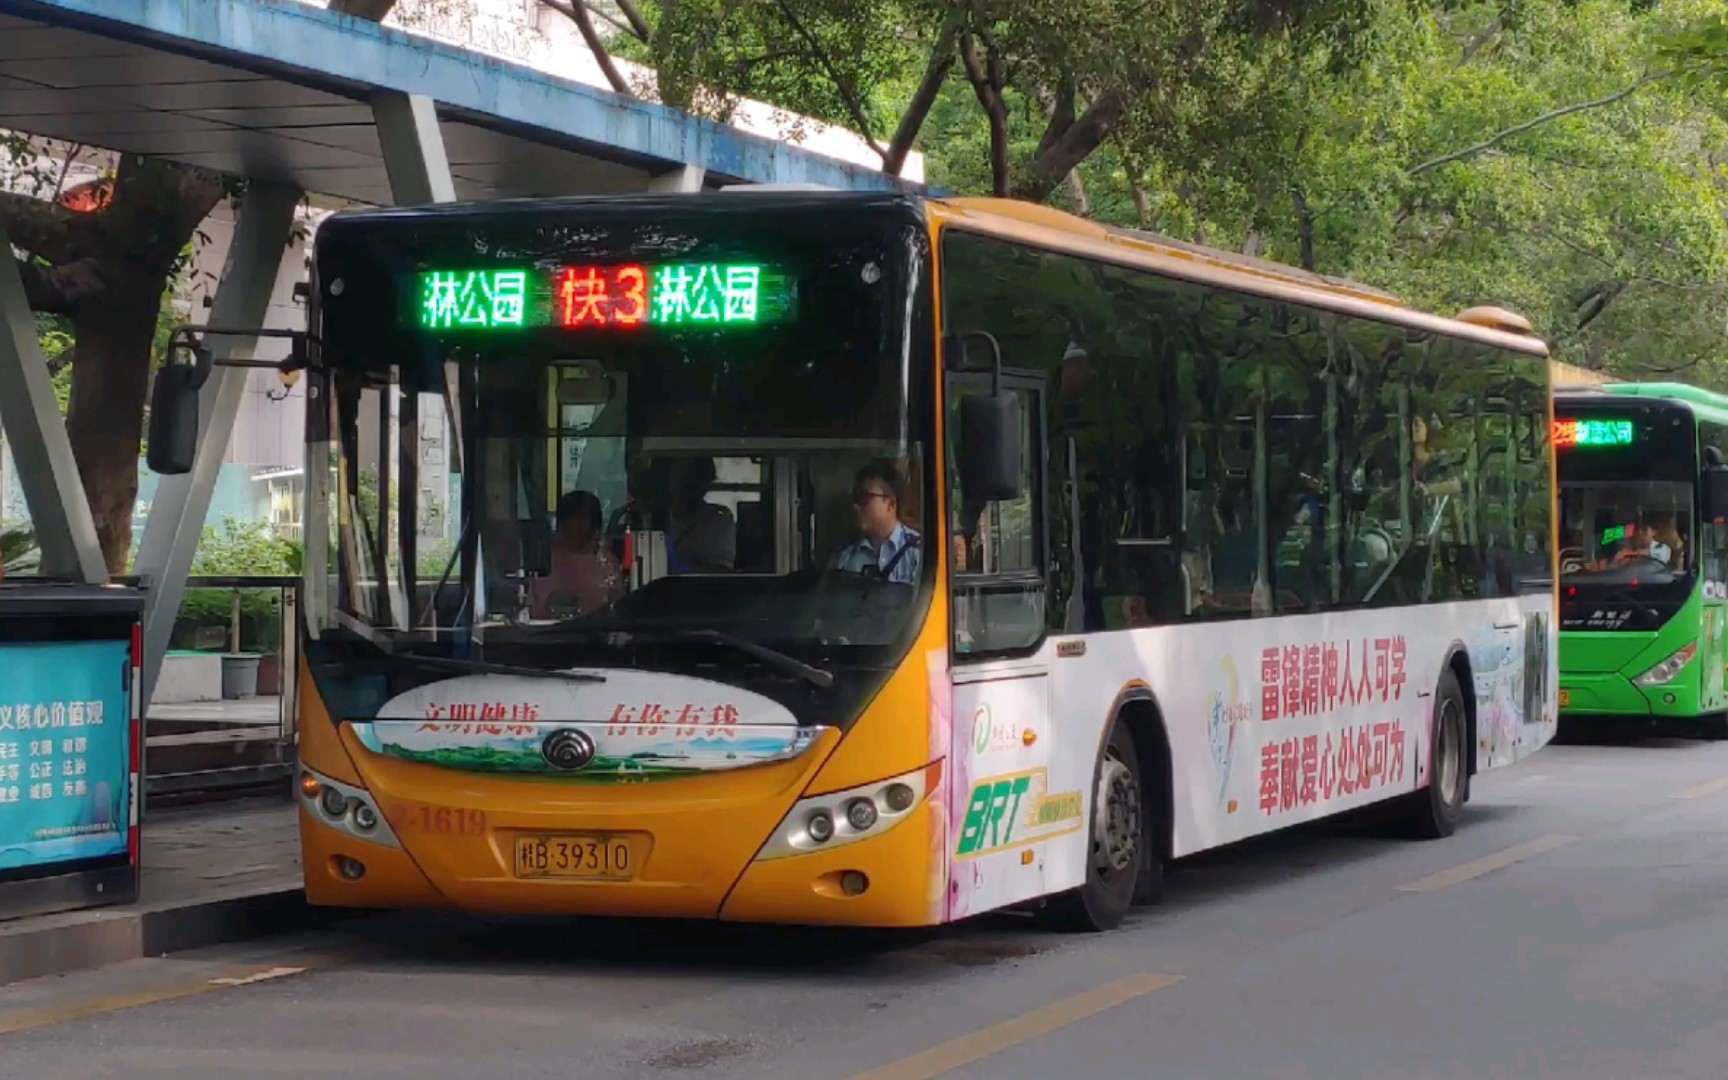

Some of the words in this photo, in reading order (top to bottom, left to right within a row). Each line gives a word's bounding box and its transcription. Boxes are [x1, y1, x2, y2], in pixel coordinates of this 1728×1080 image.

[0, 700, 104, 731] 义核心价值观
[1261, 635, 1406, 721] 雷锋精神人人可学
[416, 702, 539, 736] 文明健康
[606, 703, 739, 737] 有你有我
[1259, 718, 1405, 816] 奉献爱心处处可为
[956, 775, 1031, 855] BRT
